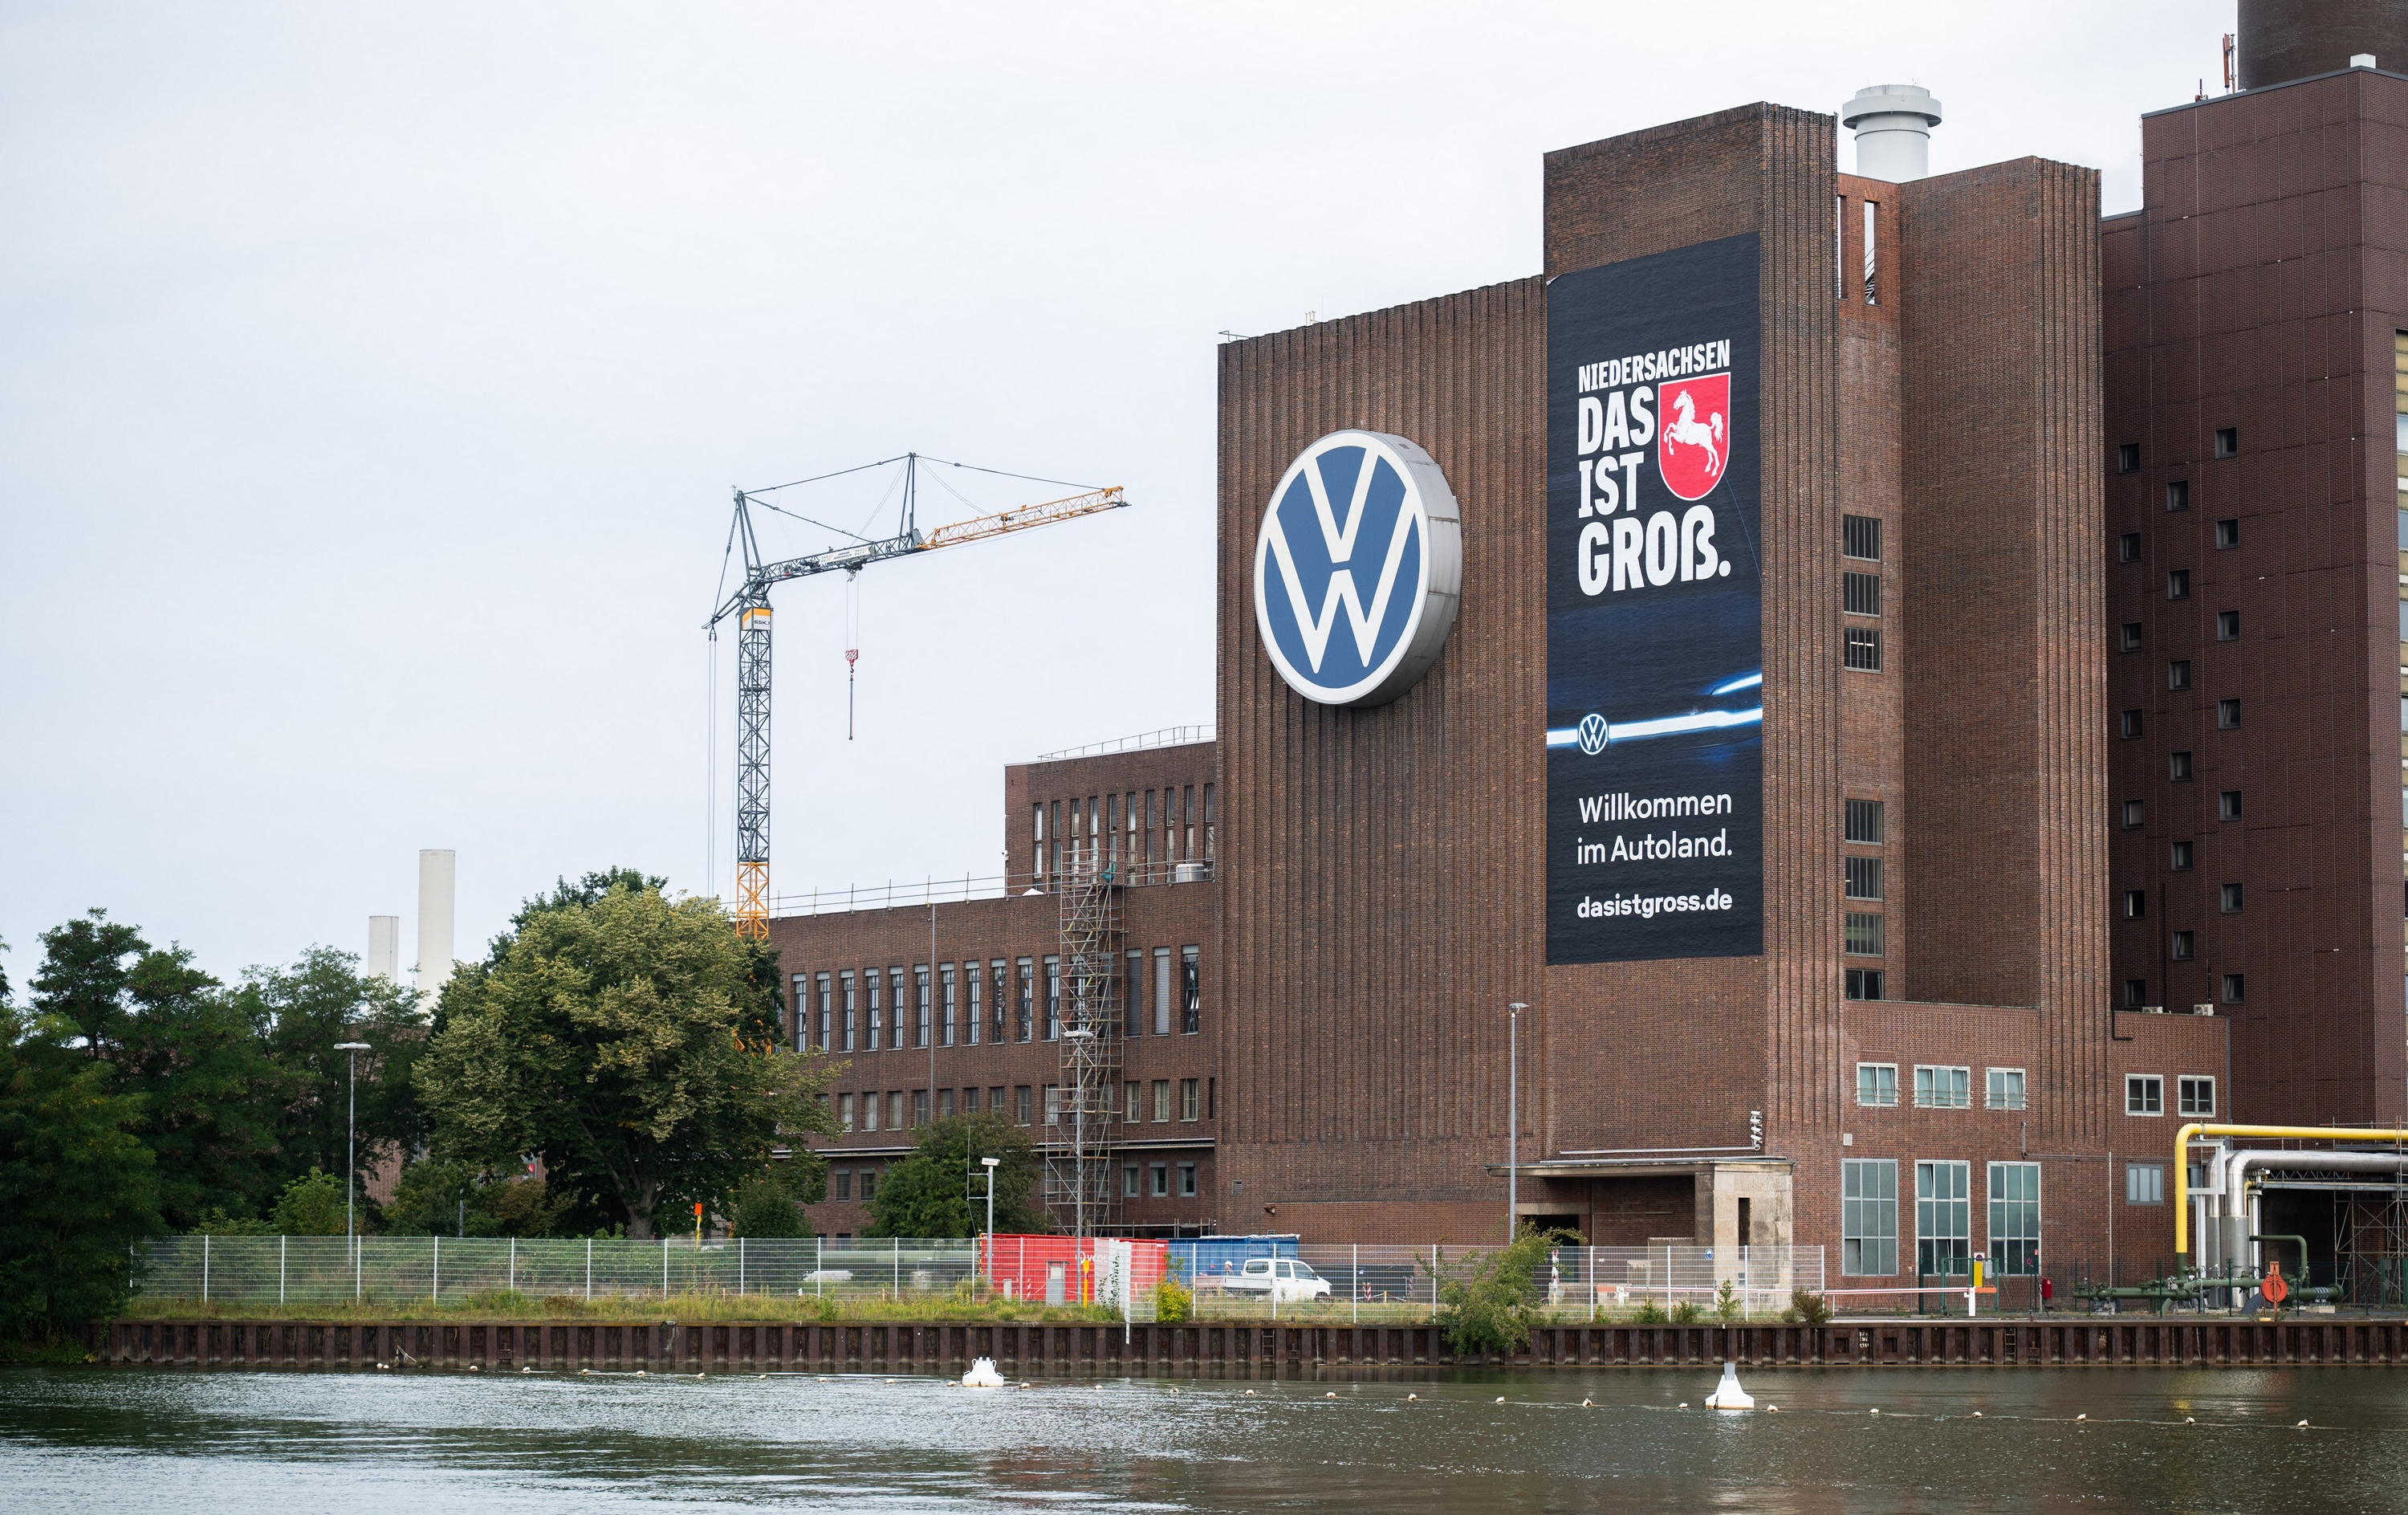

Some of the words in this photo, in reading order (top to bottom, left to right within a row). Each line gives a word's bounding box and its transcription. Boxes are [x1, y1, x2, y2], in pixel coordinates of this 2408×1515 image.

[1578, 339, 1731, 393] NIEDERSACHSEN
[1578, 386, 1655, 455] DAS
[1578, 451, 1645, 518] IST
[1255, 430, 1428, 704] VW
[1578, 505, 1731, 596] GROß.
[1578, 713, 1609, 755] VW
[1579, 792, 1732, 823] Willkommen
[1577, 837, 1605, 864] im
[1610, 828, 1732, 862] Autoland.
[1577, 888, 1732, 918] dasistgross.de
